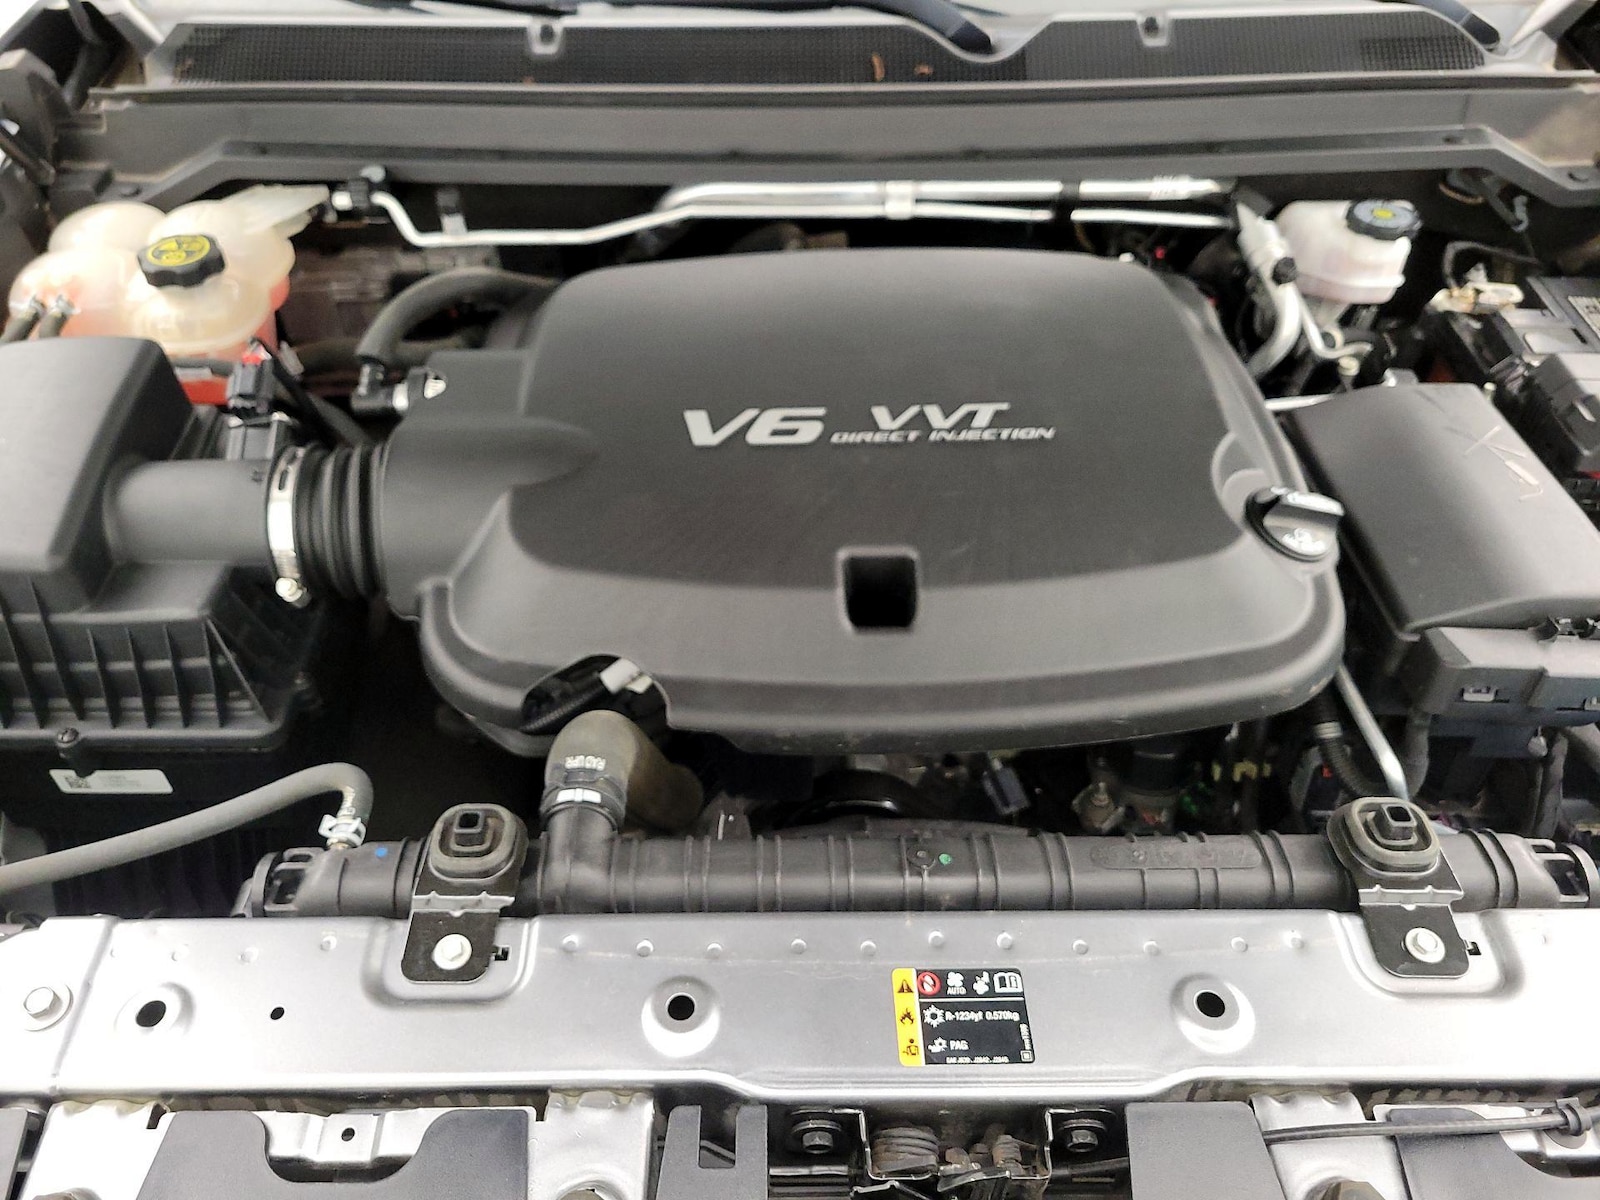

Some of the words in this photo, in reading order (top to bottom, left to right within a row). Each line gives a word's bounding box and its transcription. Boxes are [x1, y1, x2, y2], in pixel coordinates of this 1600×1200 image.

[870, 402, 1011, 430] VVT
[683, 407, 827, 446] V6
[830, 429, 922, 444] DIRECT
[928, 426, 1057, 442] INJECTION
[947, 986, 967, 995] AUTO
[949, 1039, 969, 1051] PAG
